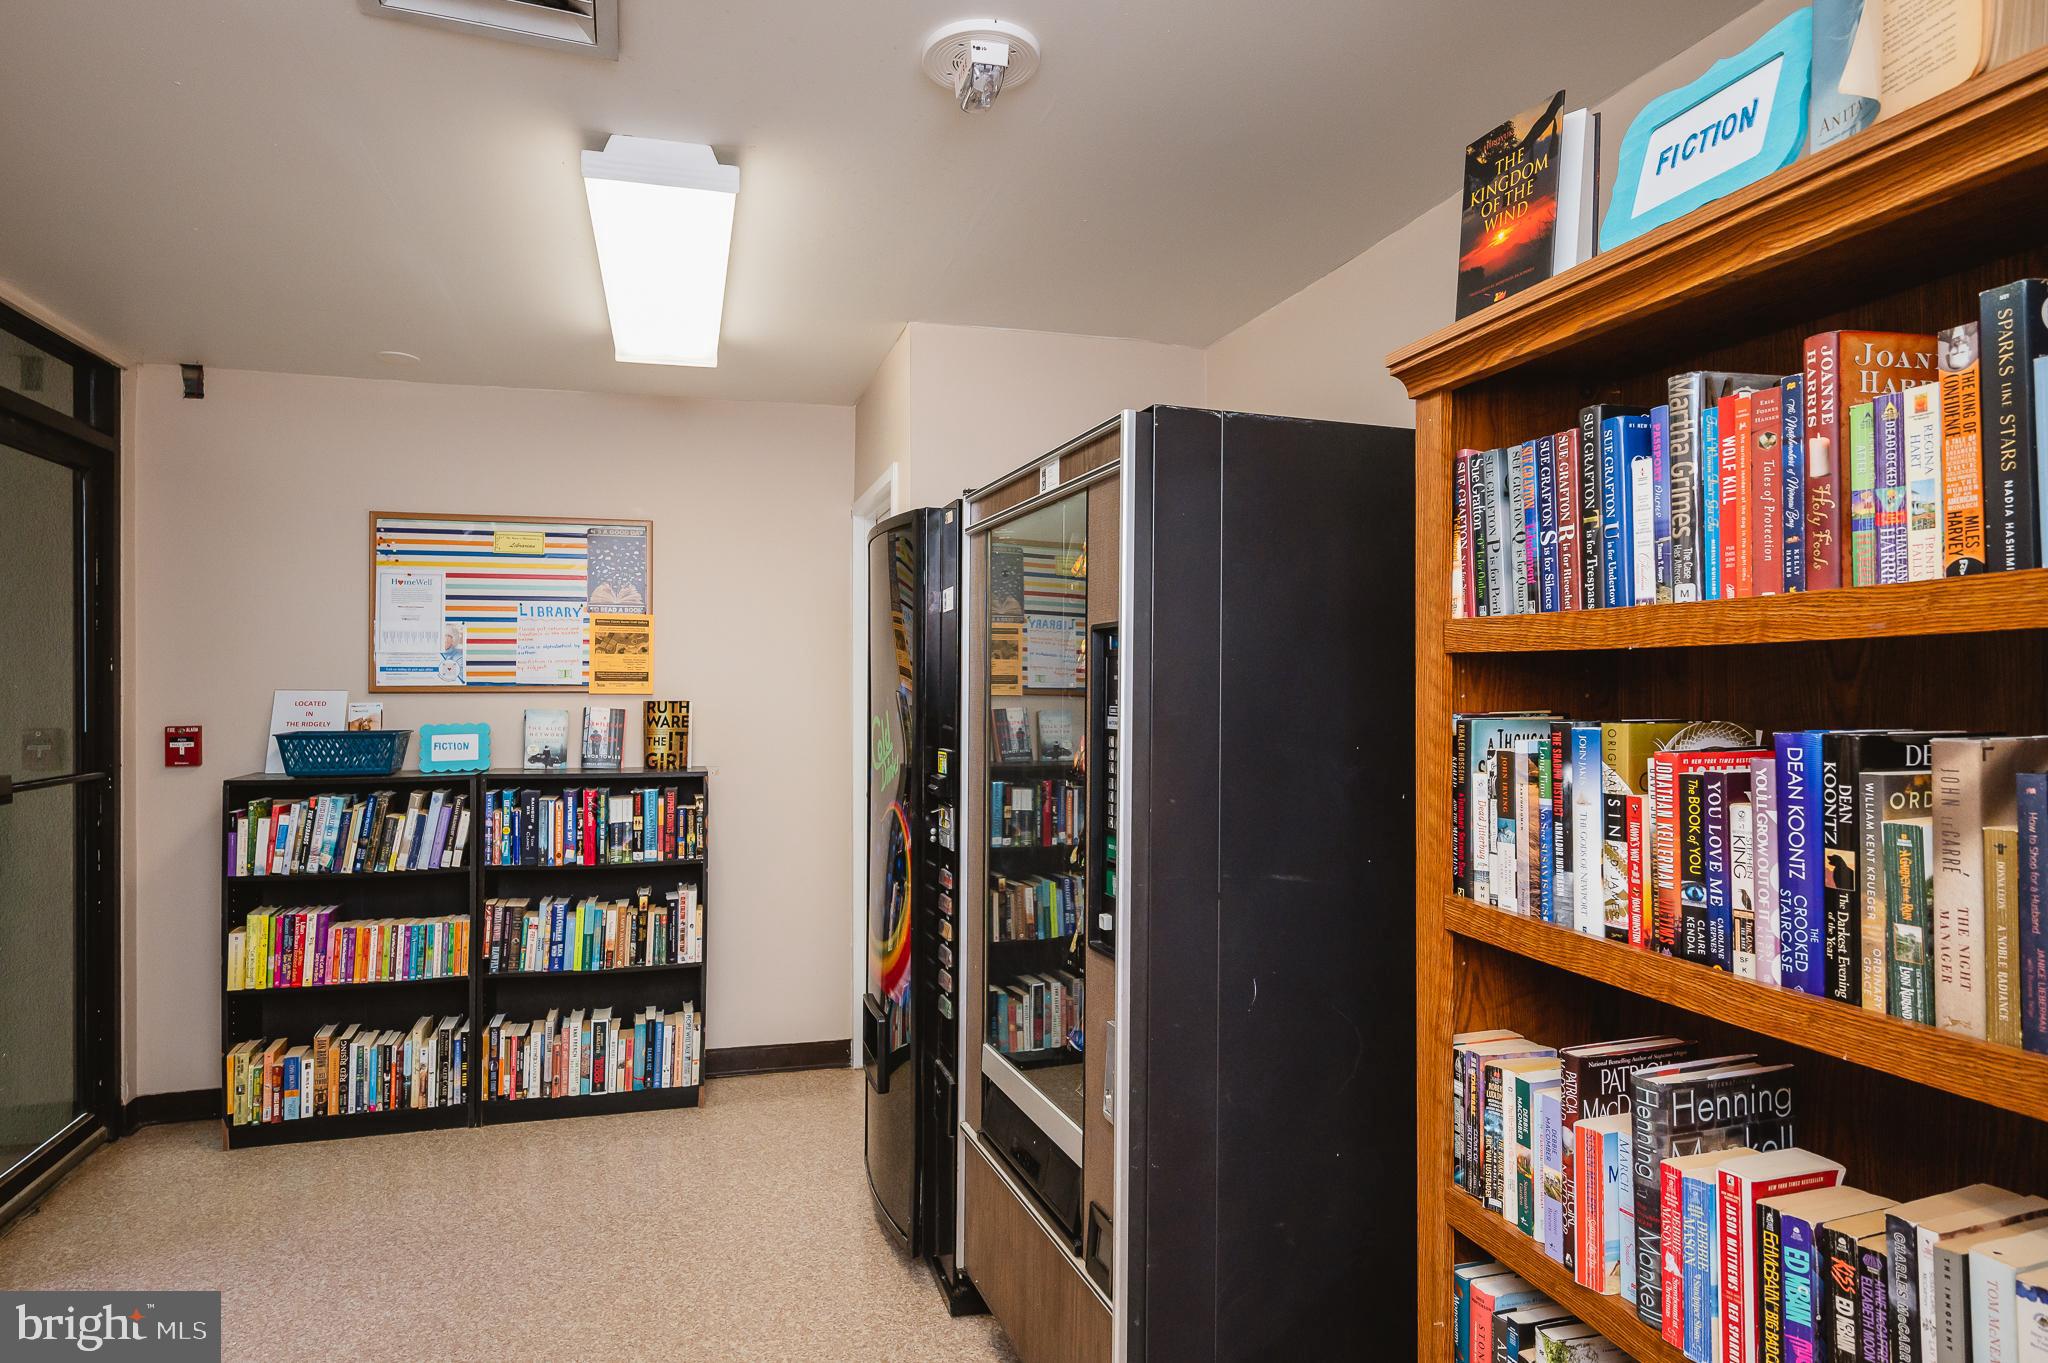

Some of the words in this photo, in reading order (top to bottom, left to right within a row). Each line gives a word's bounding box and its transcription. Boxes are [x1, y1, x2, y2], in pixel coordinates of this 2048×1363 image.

[1655, 98, 1759, 176] FICTION
[1818, 99, 1862, 137] ANITA
[1471, 153, 1549, 207] KINGDOM
[1495, 147, 1525, 176] THE
[1481, 198, 1500, 218] OF
[1504, 178, 1534, 207] THE
[1484, 200, 1528, 232] WIND
[1997, 308, 2014, 377] SPARKS
[1806, 350, 1817, 427] HARRIS
[1820, 345, 1834, 424] JOANNE
[1961, 370, 1974, 388] THE
[2000, 383, 2012, 407] LIKE
[1669, 376, 1695, 458] Martha
[1943, 373, 1961, 438] CONFIDENCE
[1962, 391, 1975, 419] KING
[1583, 413, 1594, 438] SUE
[1603, 429, 1613, 453] SUE
[2000, 414, 2017, 473] STARS
[1540, 441, 1550, 464] SUE
[1559, 435, 1568, 459] SUE
[1653, 424, 1662, 481] PASSPORT
[1722, 436, 1736, 471] WOLF
[1885, 420, 1897, 486] DEADLOCKED
[1910, 434, 1922, 468] HART
[1923, 424, 1935, 474] REGINA
[1486, 456, 1494, 479] SUE
[1584, 442, 1595, 509] GRAFTON
[1604, 456, 1615, 517] GRAFTON
[1763, 460, 1775, 487] Tales
[1473, 483, 1486, 530] Grafton
[1486, 481, 1497, 537] GRAFTON
[1512, 474, 1524, 528] GRAFTON
[1541, 467, 1553, 527] GRAFTON
[1560, 462, 1570, 520] GRAFTON
[1670, 461, 1696, 539] Grimes
[1722, 476, 1737, 506] KILL
[2004, 479, 2014, 516] NADIA
[1540, 531, 1557, 545] S
[1559, 523, 1575, 542] R
[1584, 510, 1600, 528] T
[1604, 521, 1619, 540] U
[1764, 505, 1776, 561] Protection
[1948, 512, 1963, 557] HARVEY
[1965, 515, 1980, 549] MILES
[1813, 530, 1833, 572] Fools
[2004, 522, 2016, 571] HASHIMI
[1544, 574, 1554, 609] Silence
[1563, 569, 1573, 610] Ricochet
[1587, 555, 1598, 609] Trespass
[1607, 562, 1616, 605] Undertow
[519, 605, 582, 618] LIBRARY
[646, 701, 690, 713] RUTH
[646, 716, 690, 728] WARE
[433, 742, 470, 752] FICTION
[646, 737, 667, 746] THE
[669, 732, 688, 750] IT
[1552, 749, 1563, 781] SHADOW
[1786, 747, 1803, 799] DEAN
[1553, 783, 1564, 817] DISTRICT
[1656, 760, 1673, 817] JONATHAN
[1708, 781, 1721, 819] YOU
[1754, 768, 1772, 811] YOU'LL
[1823, 762, 1837, 843] KOONTZ
[1838, 785, 1853, 824] DEAN
[1864, 782, 1875, 831] WILLIAM
[1940, 769, 1961, 807] JOHN
[1608, 799, 1621, 838] SIN
[1688, 797, 1700, 833] BOOK
[1756, 813, 1770, 856] GROW
[1540, 842, 1549, 876] SUSAN
[1657, 822, 1675, 889] KELLERMAN
[1689, 847, 1701, 875] YOU
[1708, 823, 1723, 872] LOVE
[1733, 835, 1747, 879] KING
[1787, 804, 1806, 880] KOONTZ
[1866, 835, 1875, 863] KENT
[1709, 877, 1724, 907] ME
[1838, 893, 1849, 913] The
[1866, 866, 1876, 919] KRUEGER
[1659, 899, 1675, 945] VICTIMS
[1686, 916, 1694, 954] KENDAL
[1780, 888, 1793, 973] STAIRCASE
[1793, 895, 1808, 972] CROOKED
[1837, 915, 1849, 955] Darkest
[1957, 907, 1970, 938] THE
[2030, 895, 2040, 935] Husband
[1697, 919, 1706, 955] CLAIRE
[1709, 920, 1717, 953] KEPNES
[1717, 918, 1725, 959] CAROLINE
[1827, 937, 1835, 959] Year
[1940, 911, 1954, 984] MANAGER
[1835, 958, 1849, 999] Evening
[1864, 957, 1872, 996] GRACE
[1872, 948, 1882, 1010] ORDINARY
[1958, 944, 1972, 992] NIGHT
[1998, 971, 2010, 1022] RADIANCE
[340, 1040, 348, 1066] RISING
[340, 1067, 348, 1083] RED
[1672, 1084, 1792, 1127] Henning
[1635, 1086, 1659, 1182] Henning
[1620, 1139, 1631, 1193] MARCH
[1662, 1206, 1672, 1251] MASON
[1724, 1202, 1738, 1235] JASON
[1684, 1216, 1696, 1266] MASON
[1697, 1220, 1708, 1272] DEBBIE
[1636, 1231, 1661, 1324] Mankell
[1725, 1236, 1738, 1290] MATTHEWS
[1784, 1247, 1809, 1279] ED
[1831, 1256, 1857, 1295] KISS
[1893, 1232, 1907, 1298] CHARLES
[1943, 1258, 1951, 1281] THE
[1728, 1302, 1739, 1322] RED
[1835, 1296, 1853, 1316] ED
[1860, 1275, 1873, 1329] ELIZABETH
[1985, 1280, 1999, 1309] TOM
[1944, 1286, 1952, 1351] INNOCENT
[1862, 1330, 1875, 1363] MOON
